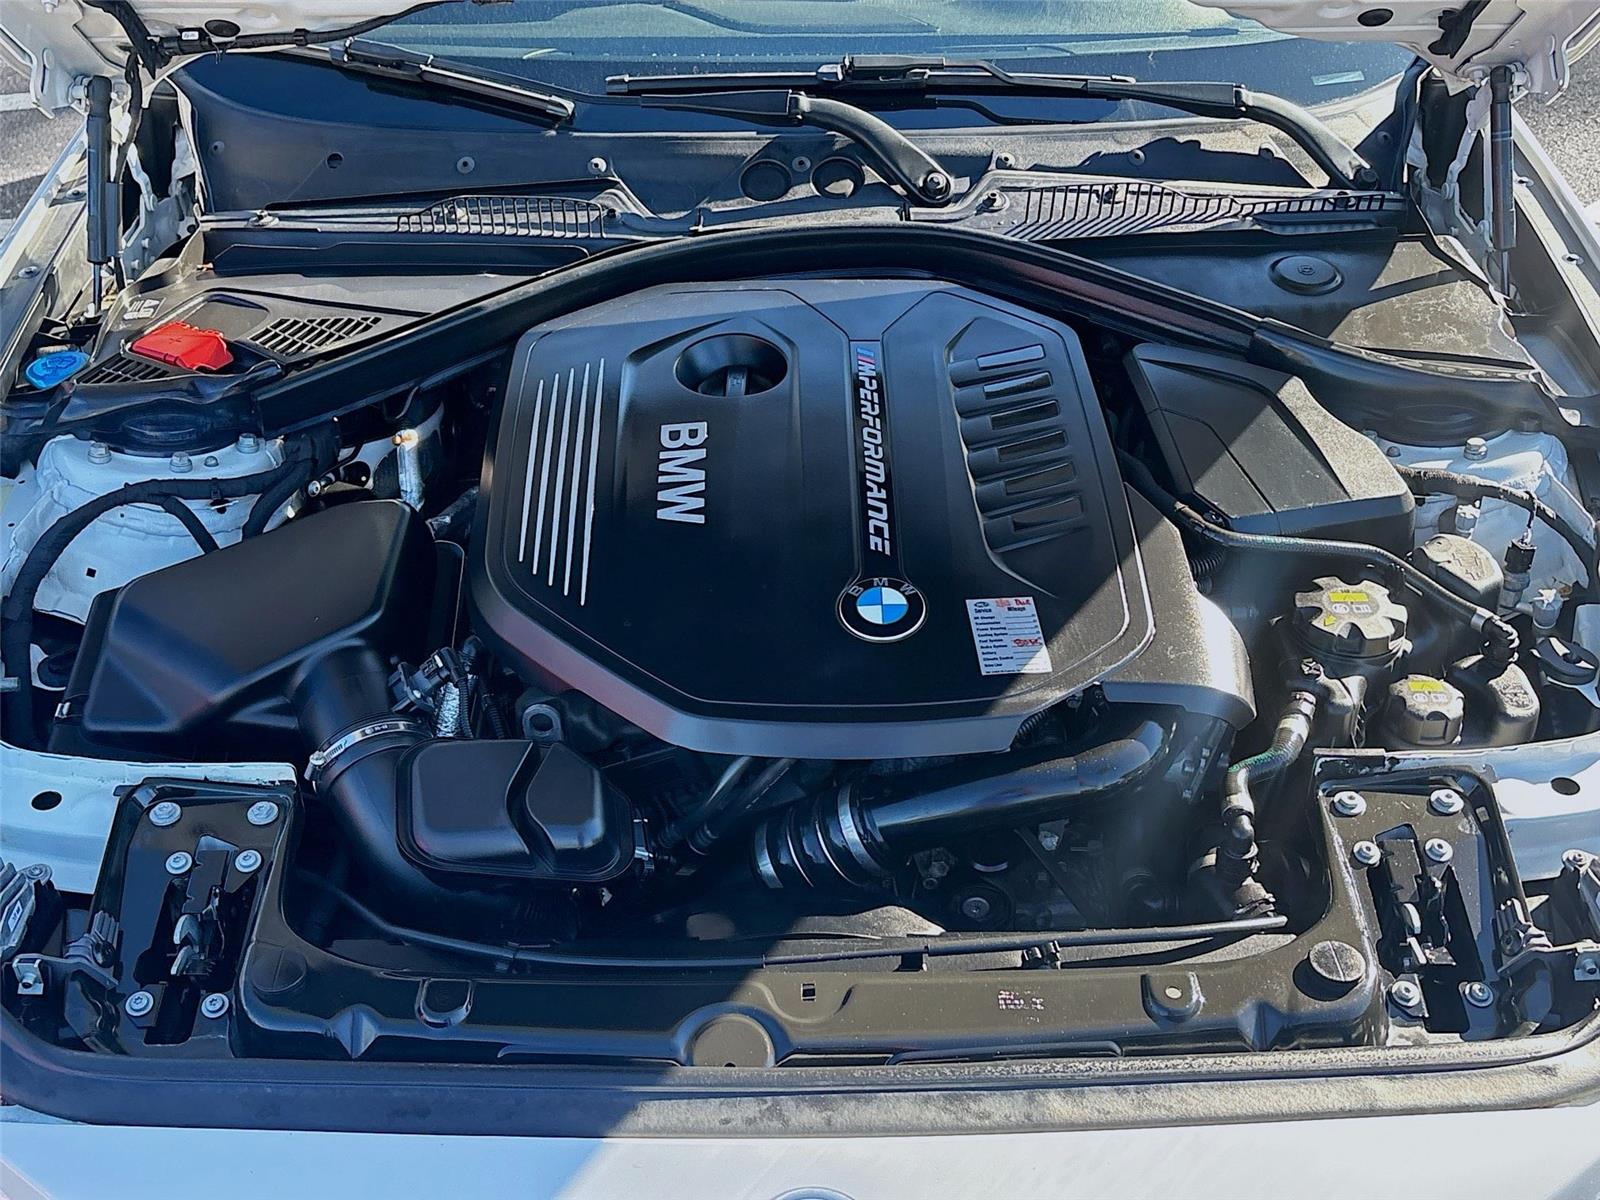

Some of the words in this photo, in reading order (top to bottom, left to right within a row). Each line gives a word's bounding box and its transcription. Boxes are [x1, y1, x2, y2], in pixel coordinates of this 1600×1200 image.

[656, 421, 709, 524] BMW
[859, 375, 891, 556] PERFORMANCE
[848, 577, 916, 597] BMW
